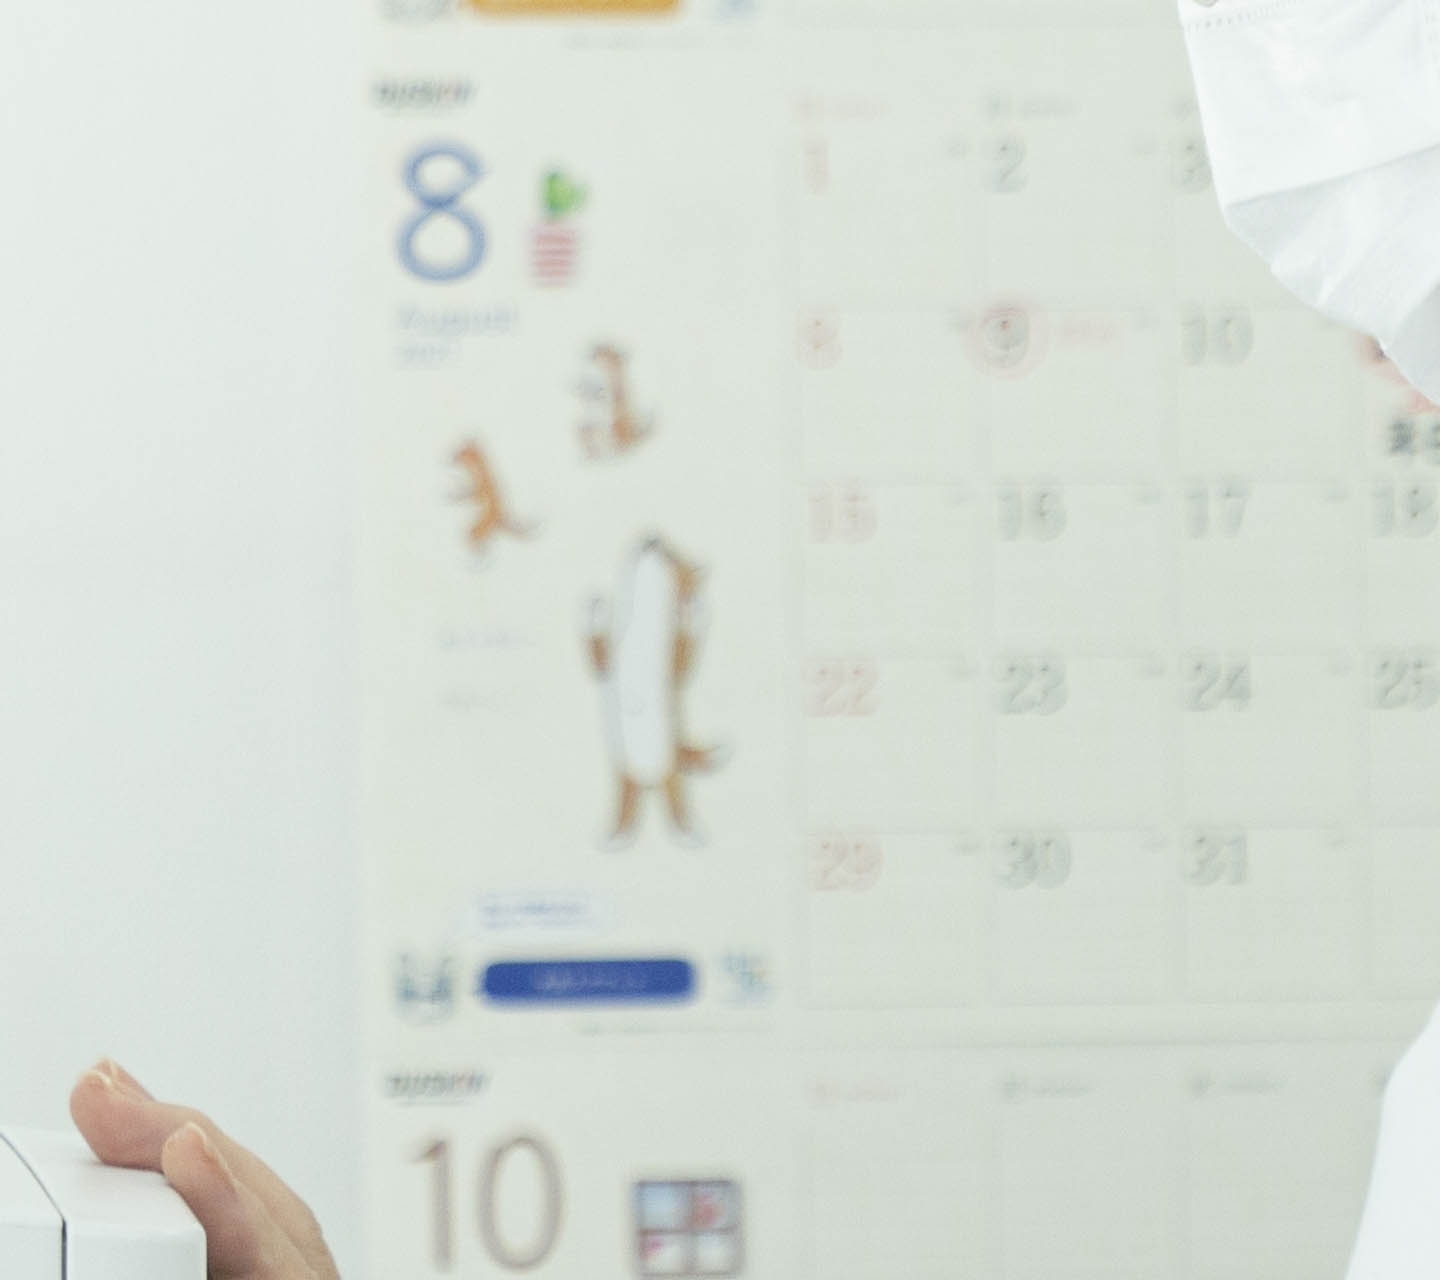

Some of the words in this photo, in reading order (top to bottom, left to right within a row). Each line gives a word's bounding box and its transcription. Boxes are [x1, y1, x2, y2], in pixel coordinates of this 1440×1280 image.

[803, 138, 831, 195] 1
[986, 136, 1027, 194] 2
[396, 141, 489, 283] 8
[1183, 307, 1253, 366] 10
[808, 478, 878, 544] 15
[998, 481, 1066, 541] 16
[1185, 477, 1248, 539] 17
[1373, 480, 1437, 536] 18
[804, 657, 878, 717] 22
[997, 654, 1067, 715] 23
[1186, 655, 1253, 712] 24
[1373, 651, 1440, 709] 25
[808, 832, 883, 891] 29
[995, 831, 1071, 888] 30
[1185, 827, 1249, 886] 31
[413, 1132, 565, 1273] 10
